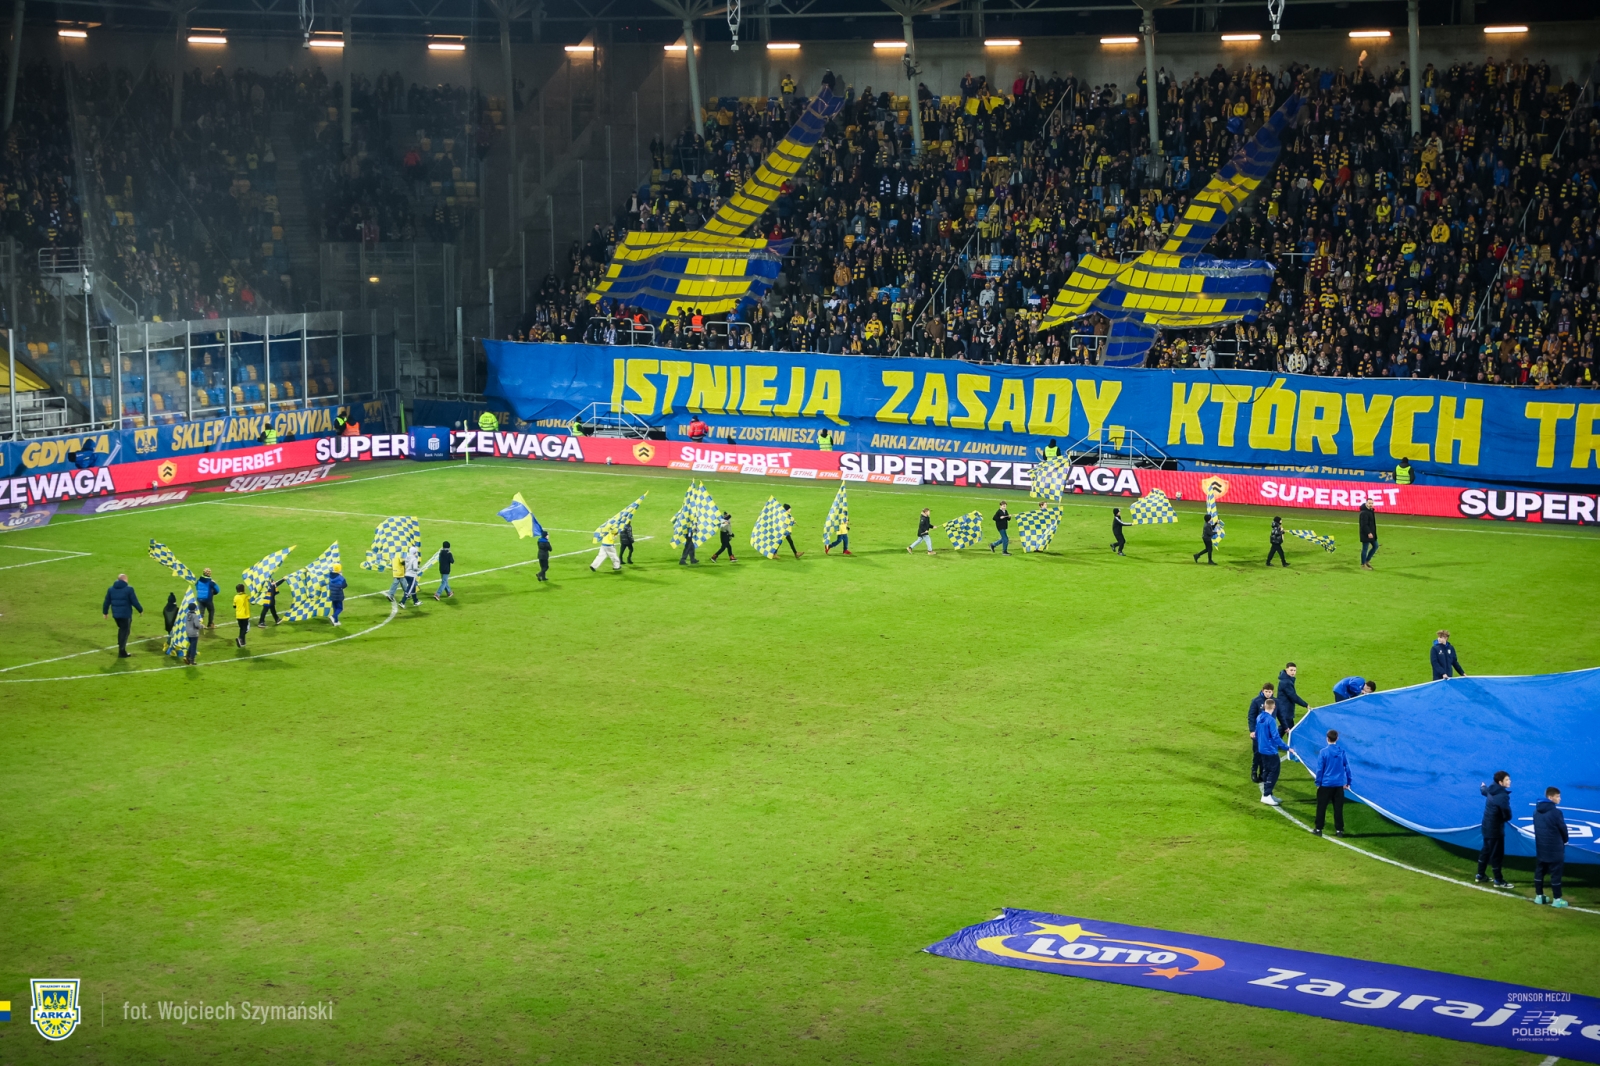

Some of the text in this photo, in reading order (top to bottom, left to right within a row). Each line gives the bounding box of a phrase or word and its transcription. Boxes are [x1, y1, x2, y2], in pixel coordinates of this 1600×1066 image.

[610, 358, 849, 426] ISTNIEJĄ
[875, 370, 1126, 450] ZASADY,
[1167, 378, 1484, 466] KTÓRYCH
[716, 426, 737, 440] NIE
[738, 427, 814, 445] ZOSTANIESZ
[870, 433, 907, 449] ARKA
[908, 436, 961, 454] ZNACZY
[197, 448, 284, 474] SUPERBET
[680, 446, 793, 468] SUPERBET
[225, 463, 336, 493] SUPERBET
[870, 474, 892, 482] STIHL
[1260, 480, 1400, 507] SUPERBET
[1460, 489, 1600, 522] SUPER
[1027, 937, 1177, 964] LOTTO
[1247, 967, 1521, 1027] Zagraj
